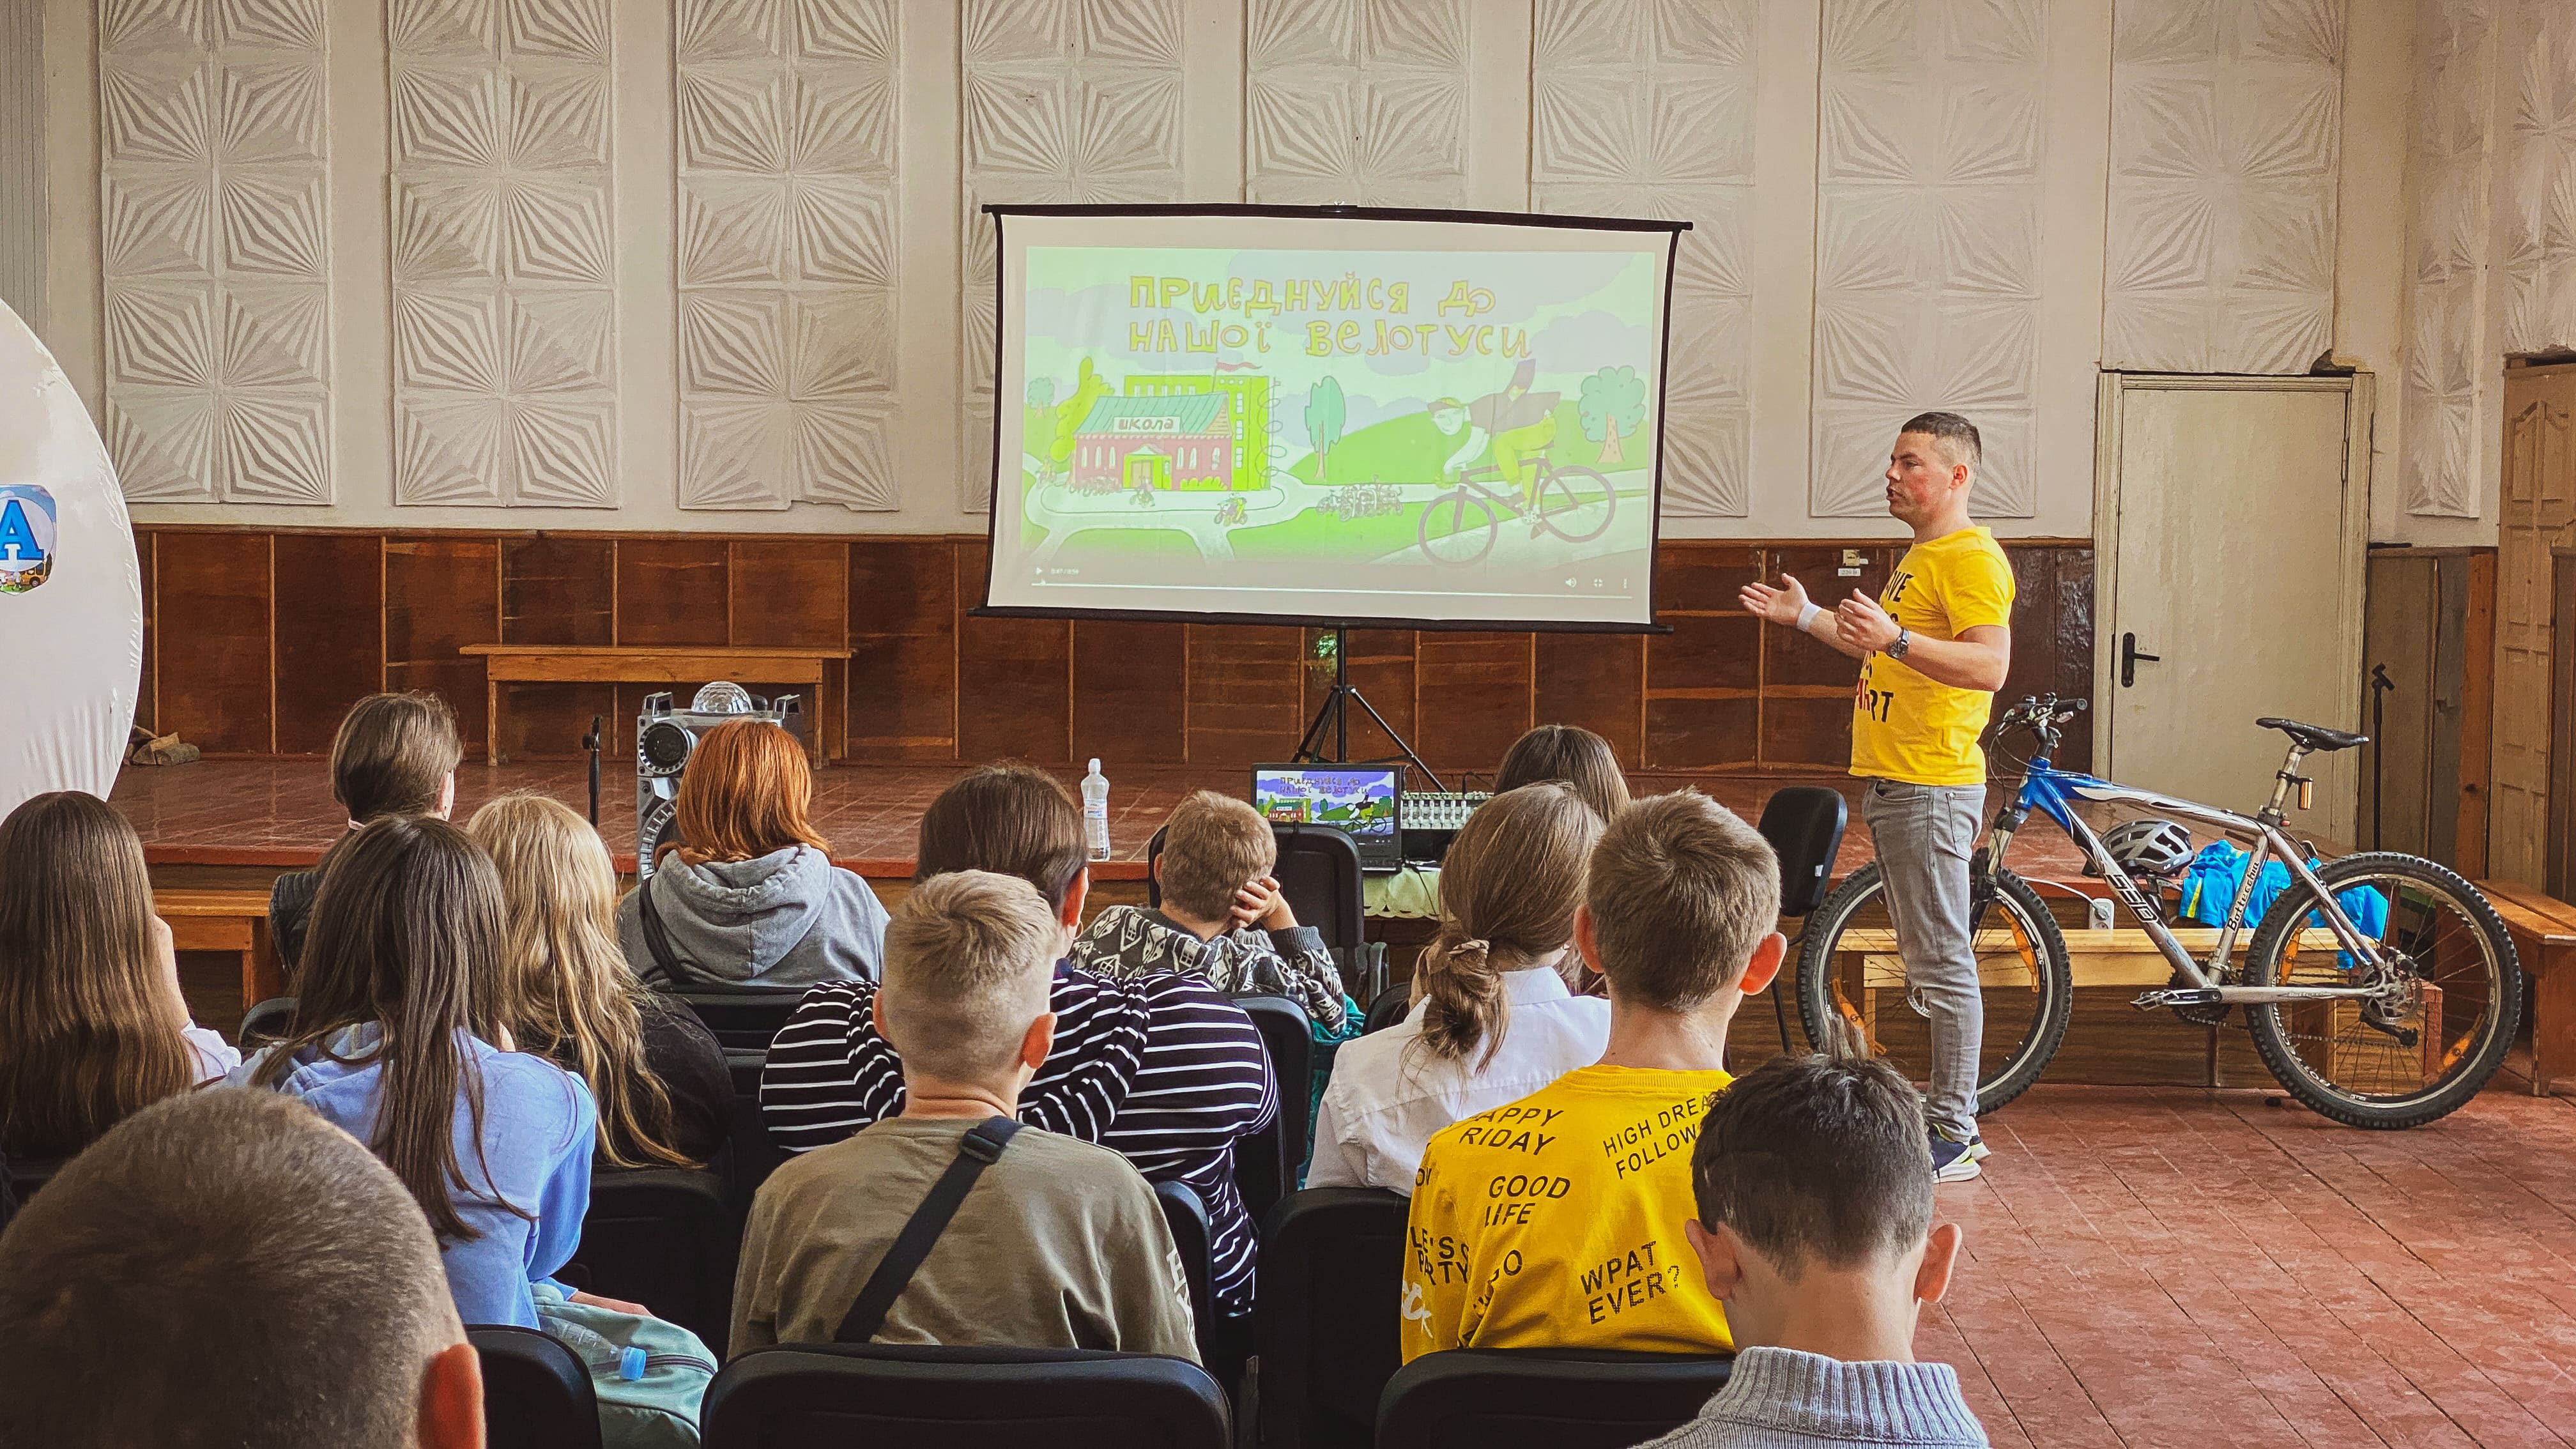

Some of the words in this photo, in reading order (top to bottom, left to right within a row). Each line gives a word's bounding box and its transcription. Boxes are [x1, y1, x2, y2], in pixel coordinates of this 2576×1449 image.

[1130, 271, 1409, 318] ПРИЄДНУЙСЯ
[1438, 280, 1496, 317] ДО
[1129, 318, 1271, 353] НАШОЇ
[1474, 1107, 1564, 1127] APPY
[1603, 1119, 1652, 1158] HIGH
[1658, 1095, 1710, 1128] DREA
[1616, 1124, 1697, 1179] FOLLOW
[1489, 1175, 1570, 1199] GOOD
[1485, 1203, 1536, 1227] LIFE
[1581, 1241, 1656, 1295] WPAT
